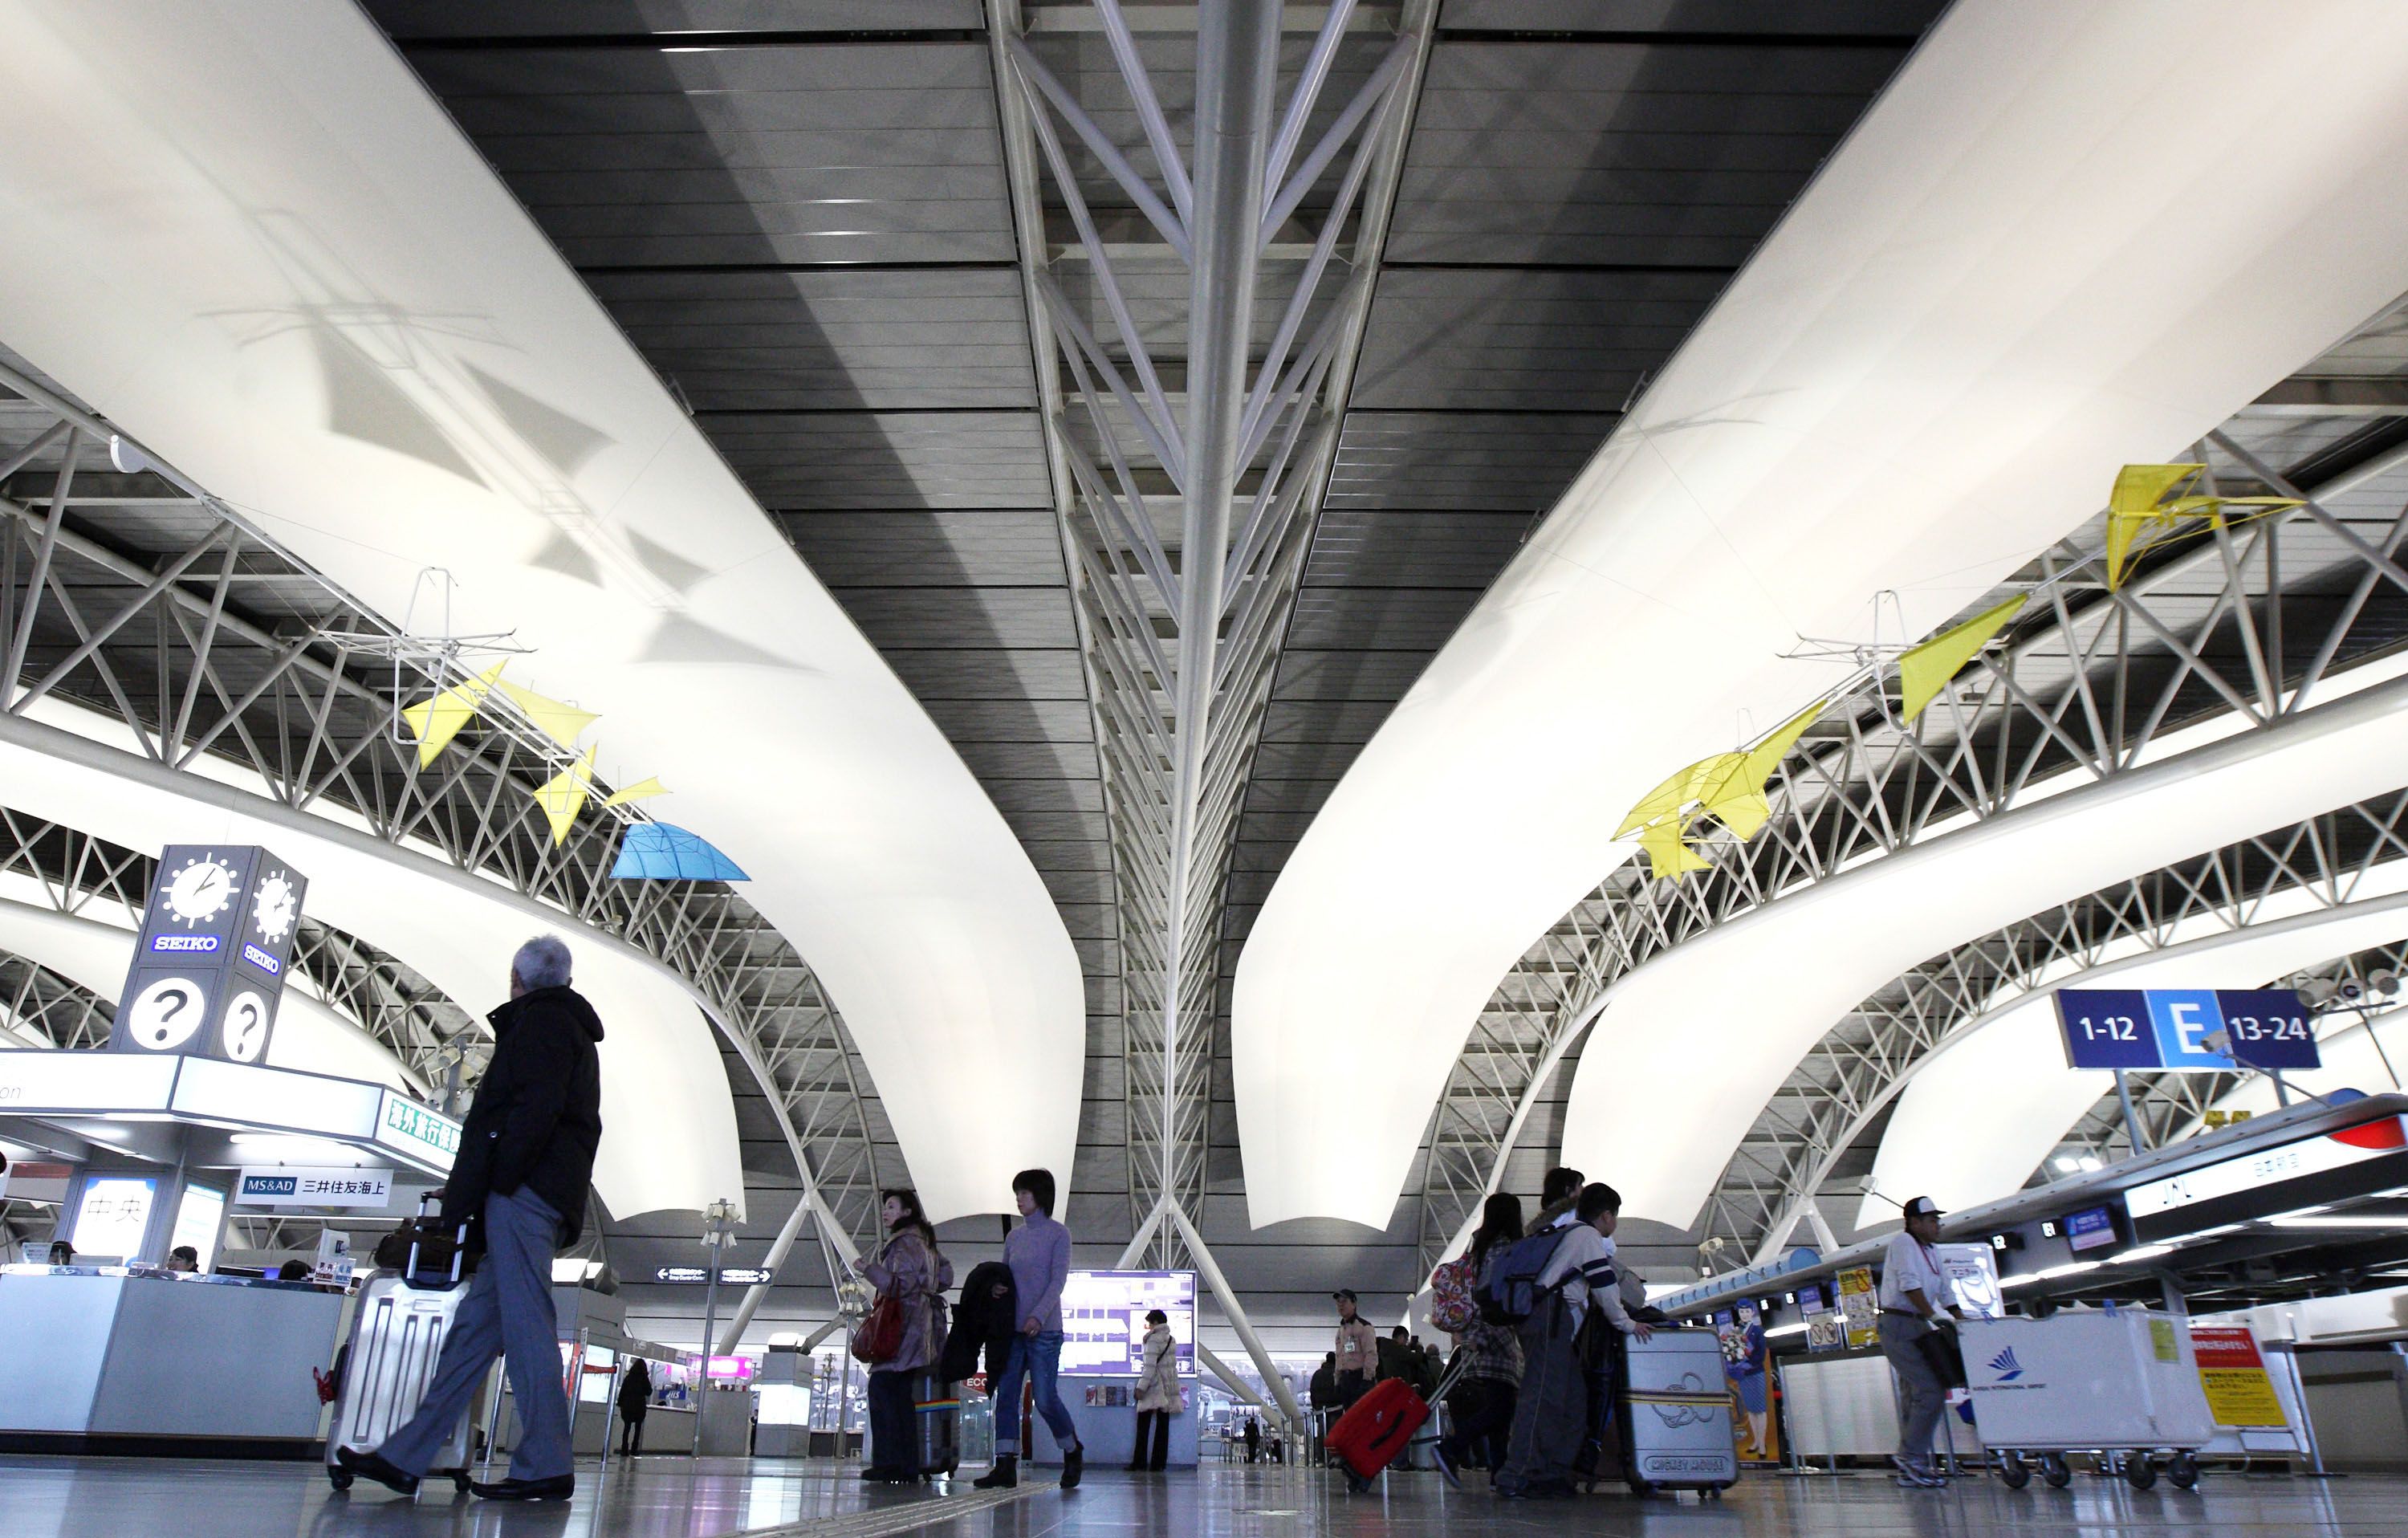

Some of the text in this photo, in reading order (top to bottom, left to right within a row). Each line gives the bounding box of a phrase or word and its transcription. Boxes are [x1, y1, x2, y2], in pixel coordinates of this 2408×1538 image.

[154, 936, 218, 951] SEIKO
[243, 944, 279, 973] SEIKO
[2079, 1003, 2308, 1053] 1-12 E 13-24
[247, 1180, 384, 1195] MS&AD 三井住友海上
[87, 1194, 142, 1223] 中央
